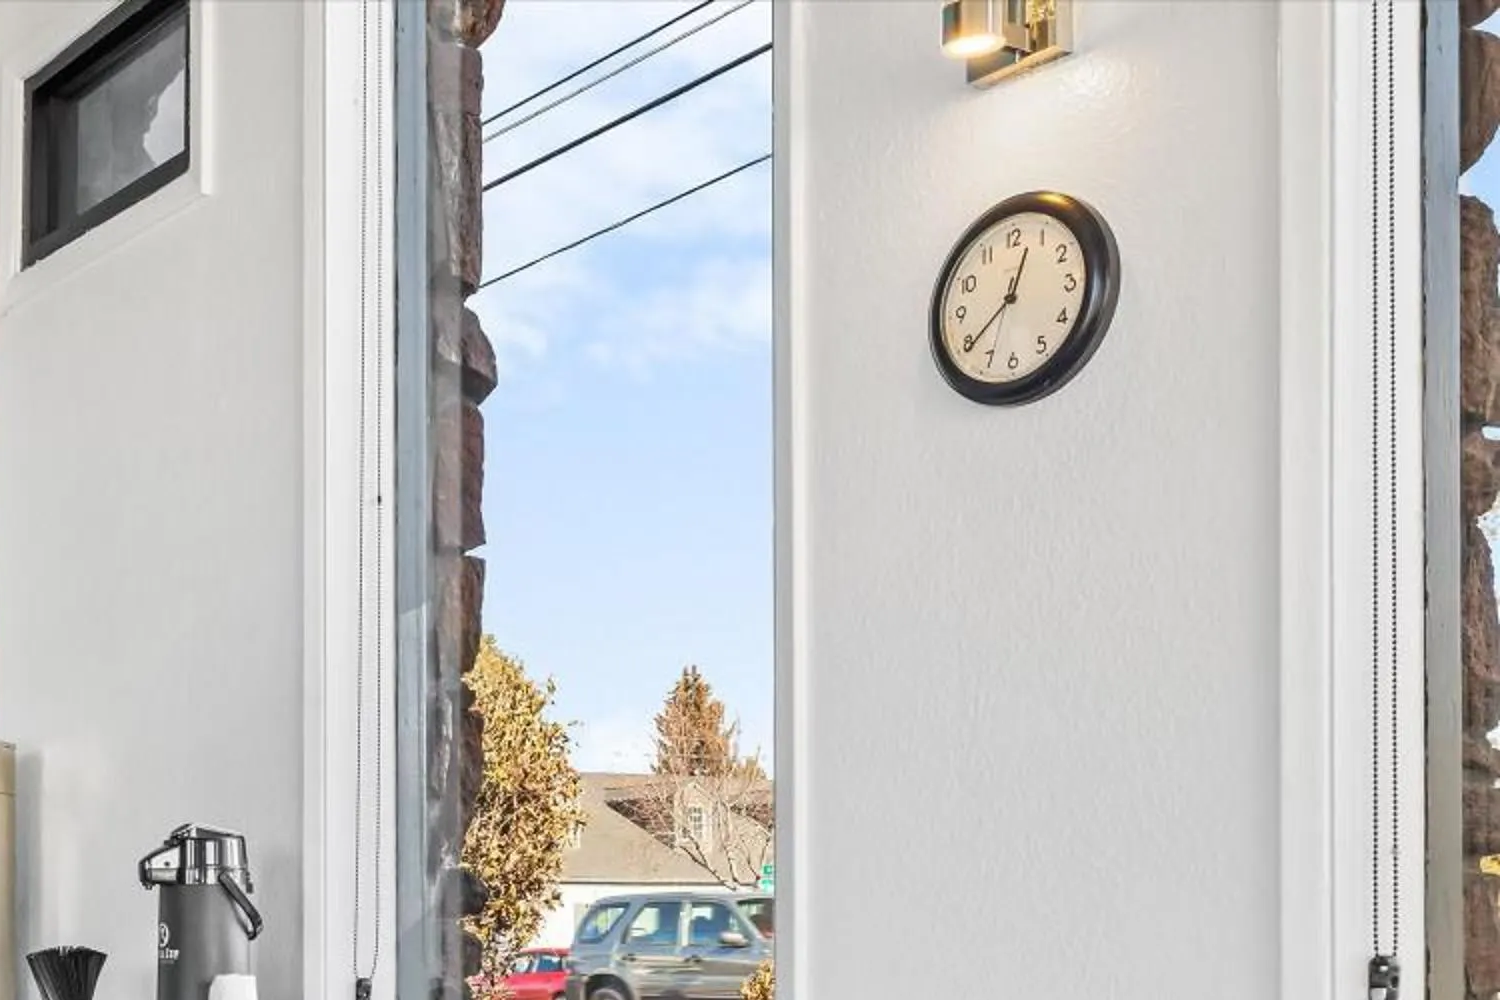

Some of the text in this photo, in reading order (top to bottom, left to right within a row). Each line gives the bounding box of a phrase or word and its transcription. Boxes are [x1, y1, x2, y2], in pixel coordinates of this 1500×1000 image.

[1005, 228, 1021, 247] 12
[1039, 228, 1045, 246] 1
[981, 246, 993, 264] 11
[1055, 244, 1067, 263] 2
[962, 275, 976, 294] 10
[1063, 274, 1077, 292] 3
[955, 305, 966, 323] 9
[1056, 307, 1068, 323] 4
[964, 335, 974, 353] 8
[1036, 336, 1046, 354] 5
[985, 350, 995, 368] 7
[1008, 352, 1018, 369] 6
